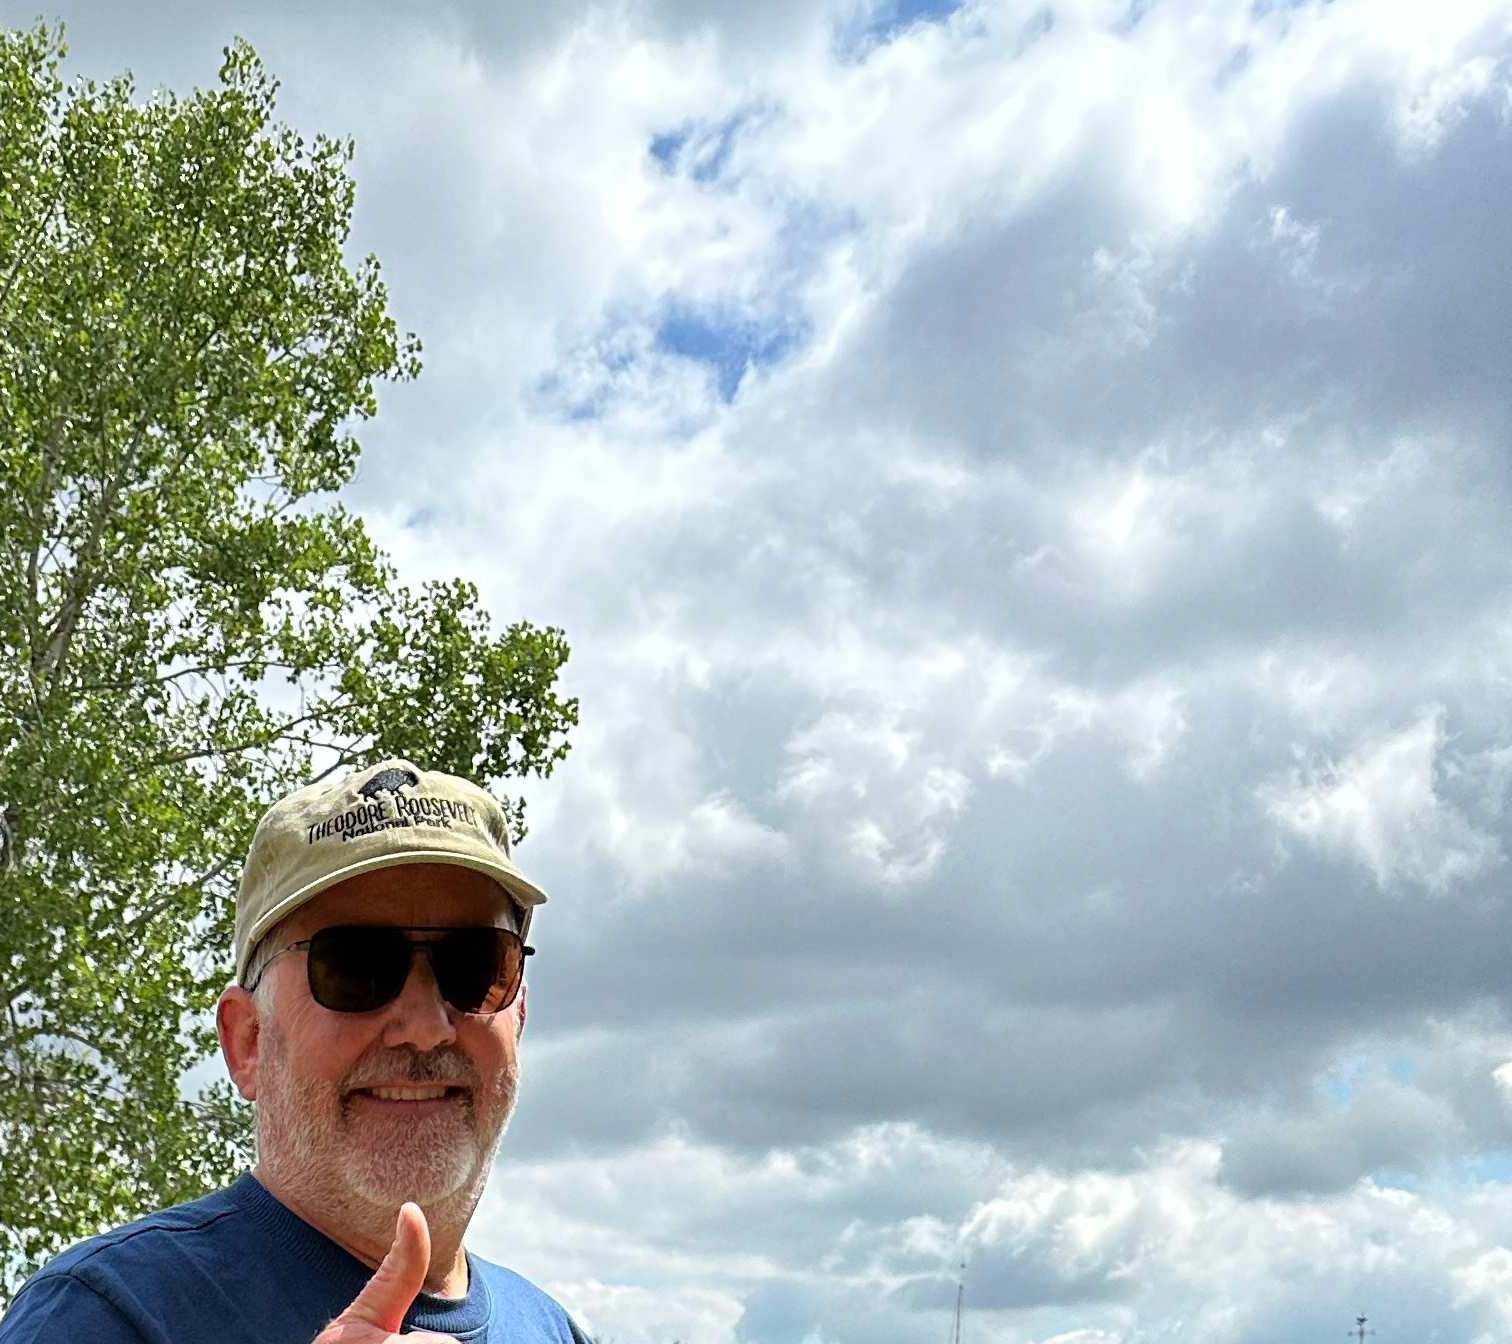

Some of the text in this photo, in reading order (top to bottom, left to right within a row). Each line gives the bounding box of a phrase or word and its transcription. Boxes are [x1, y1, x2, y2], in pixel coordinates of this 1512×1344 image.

[307, 795, 478, 845] THEODORE ROOSEVELT
[342, 815, 452, 842] National Park
